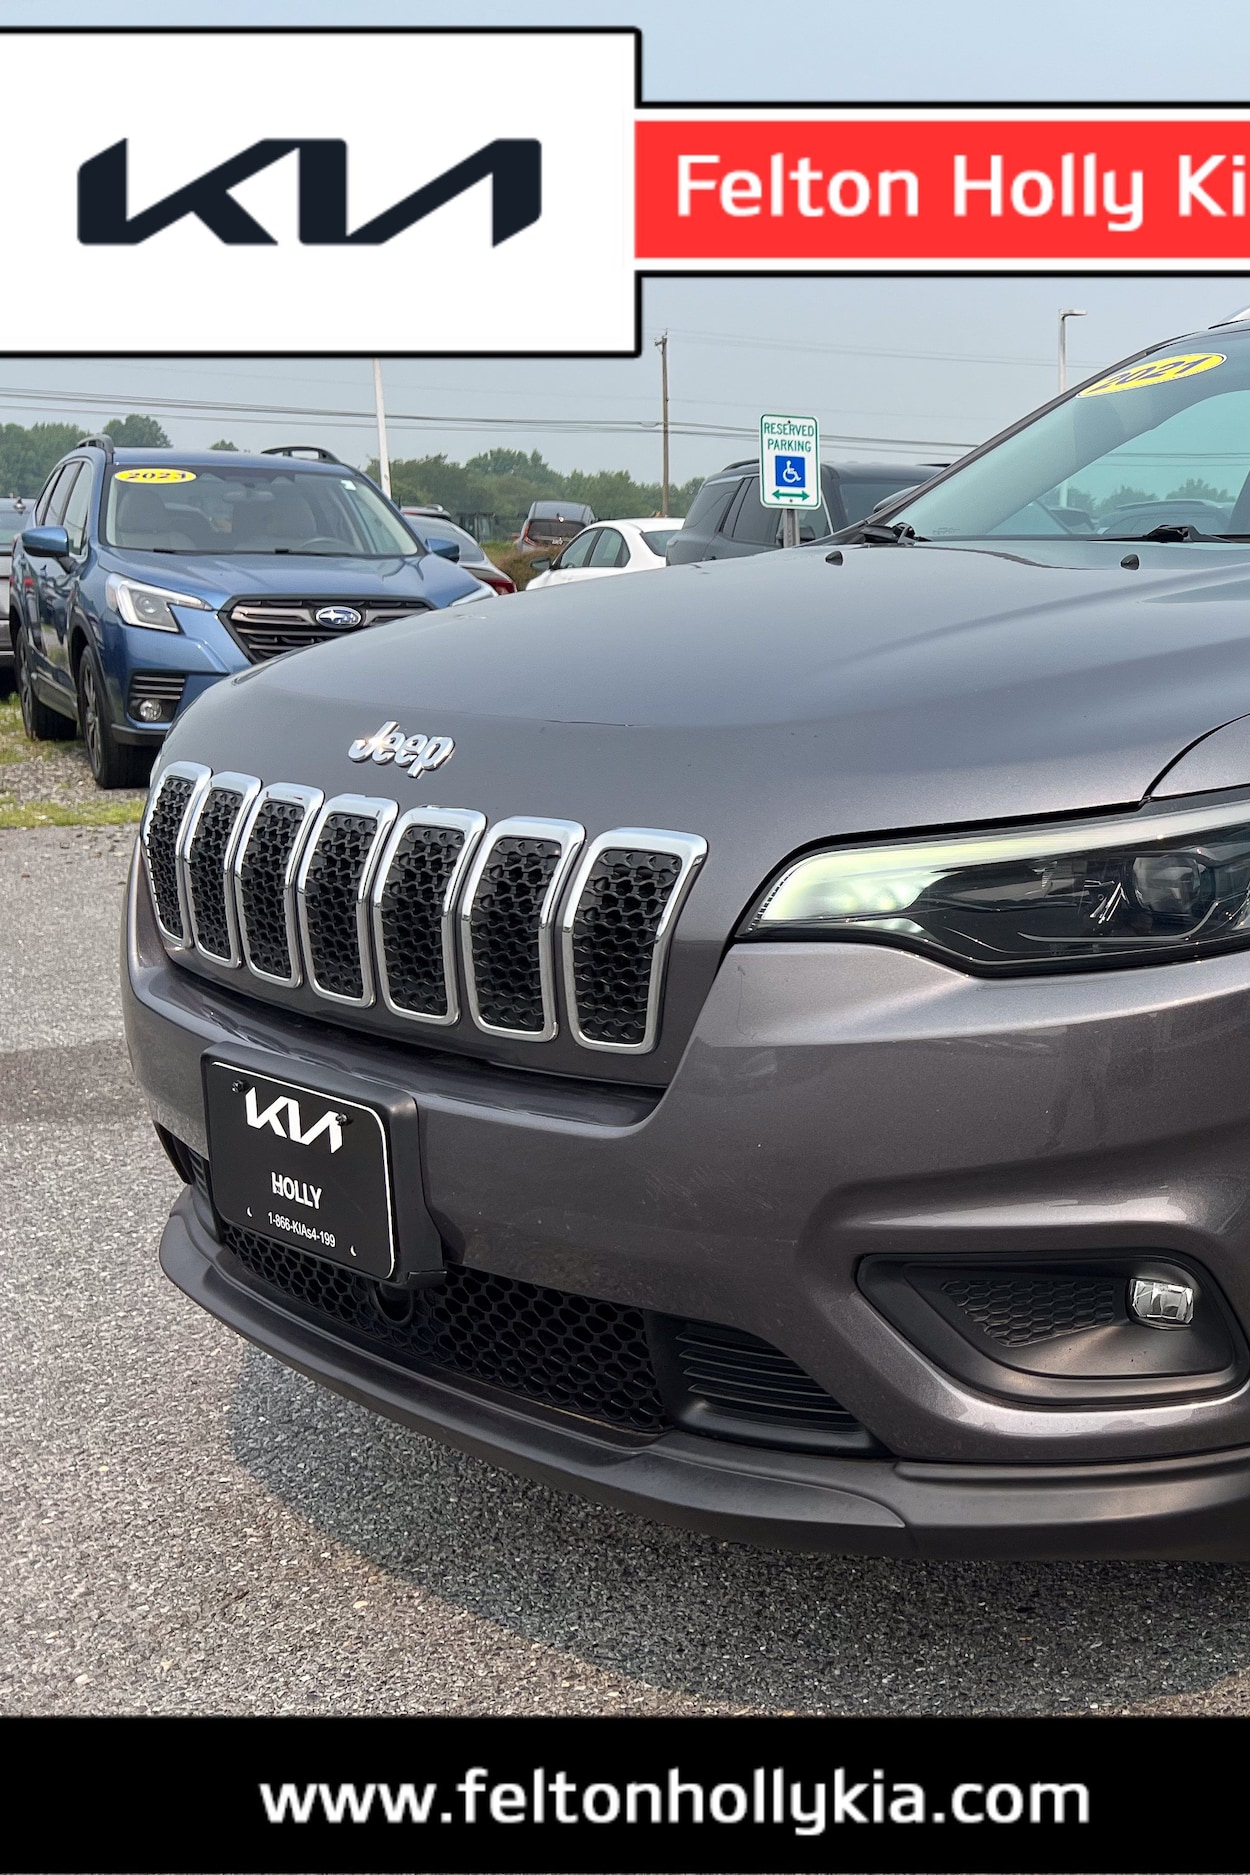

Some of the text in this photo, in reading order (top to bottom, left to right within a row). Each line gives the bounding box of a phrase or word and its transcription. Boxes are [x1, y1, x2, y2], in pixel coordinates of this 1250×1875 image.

[1086, 355, 1212, 394] 2021
[763, 421, 815, 437] RESERVED
[767, 438, 812, 453] PARKING
[348, 720, 455, 779] Jeep
[245, 1086, 344, 1153] KIA
[271, 1171, 322, 1210] HOLLY
